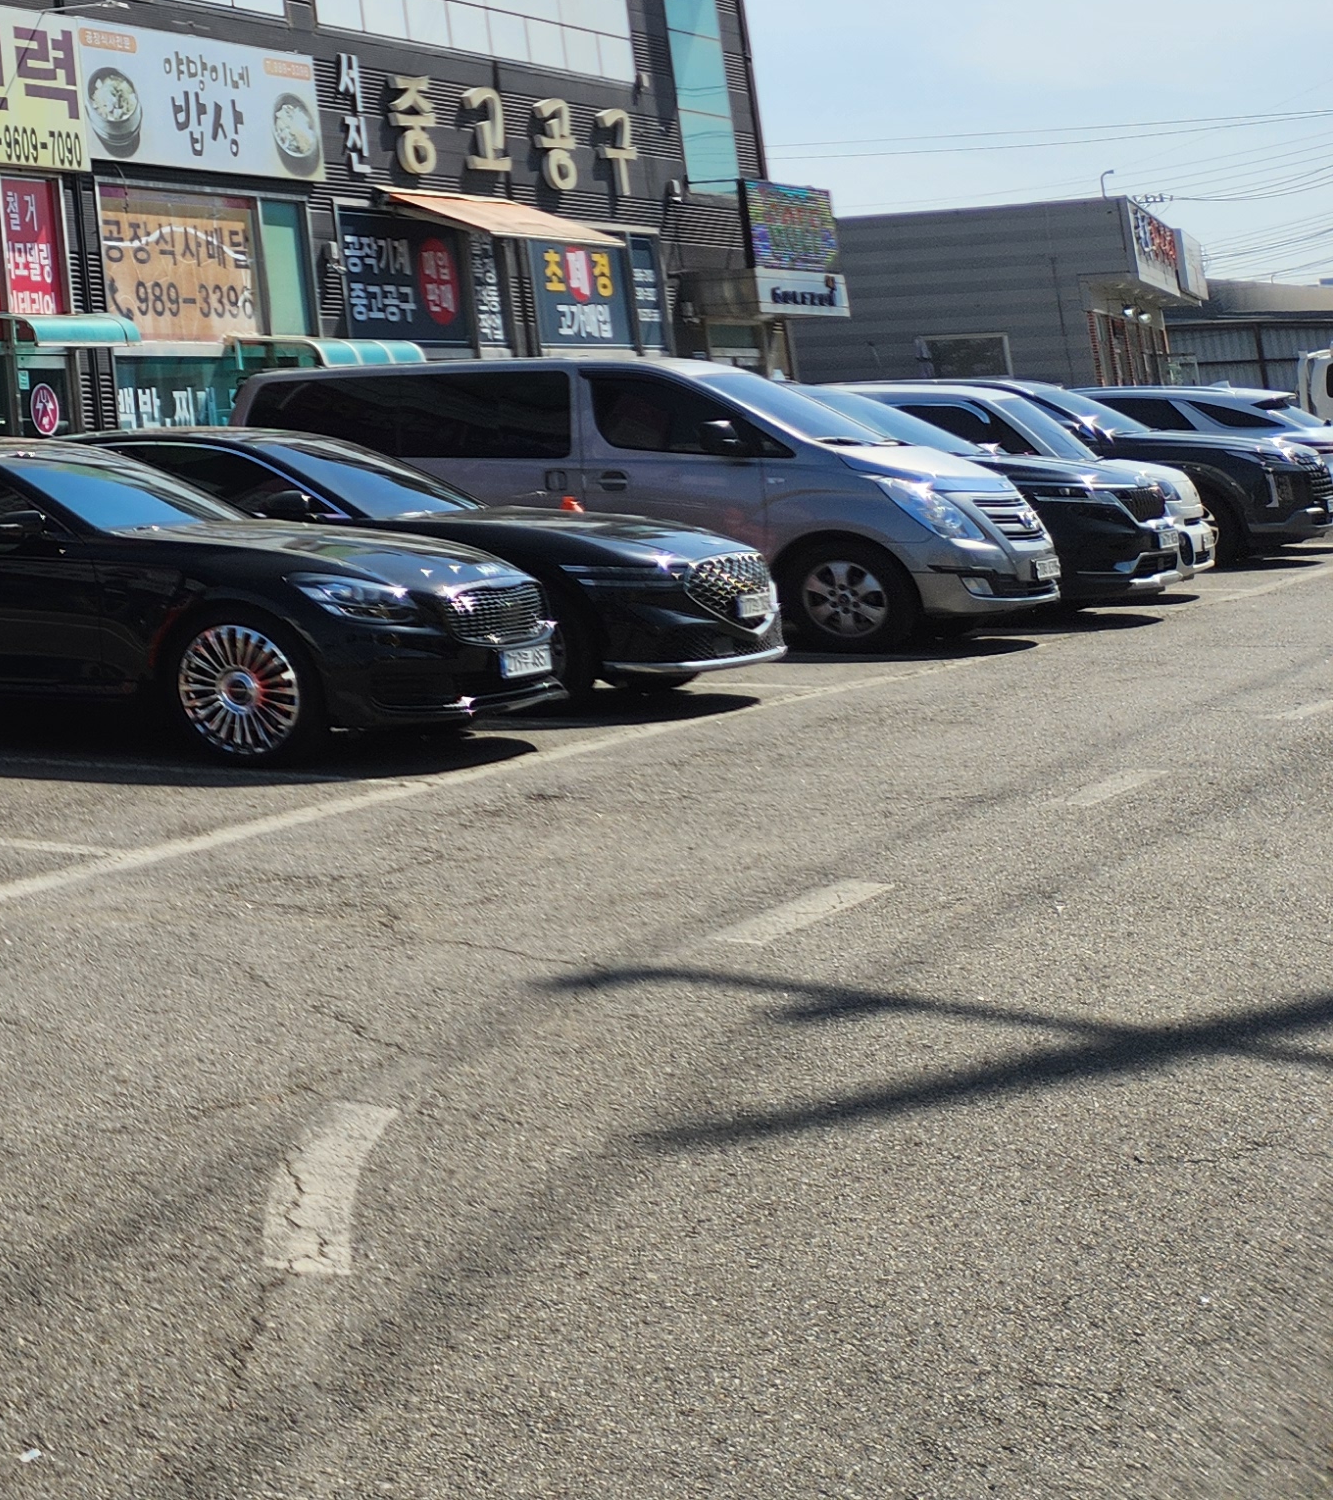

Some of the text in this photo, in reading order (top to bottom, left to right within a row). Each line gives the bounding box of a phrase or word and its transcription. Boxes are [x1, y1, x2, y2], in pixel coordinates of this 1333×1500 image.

[170, 90, 244, 157] 밥상
[388, 74, 637, 196] 중고공구
[101, 219, 251, 270] 공장식사배달
[343, 234, 412, 275] 공작기계
[349, 282, 417, 323] 중고공구
[555, 304, 614, 339] 고가매입
